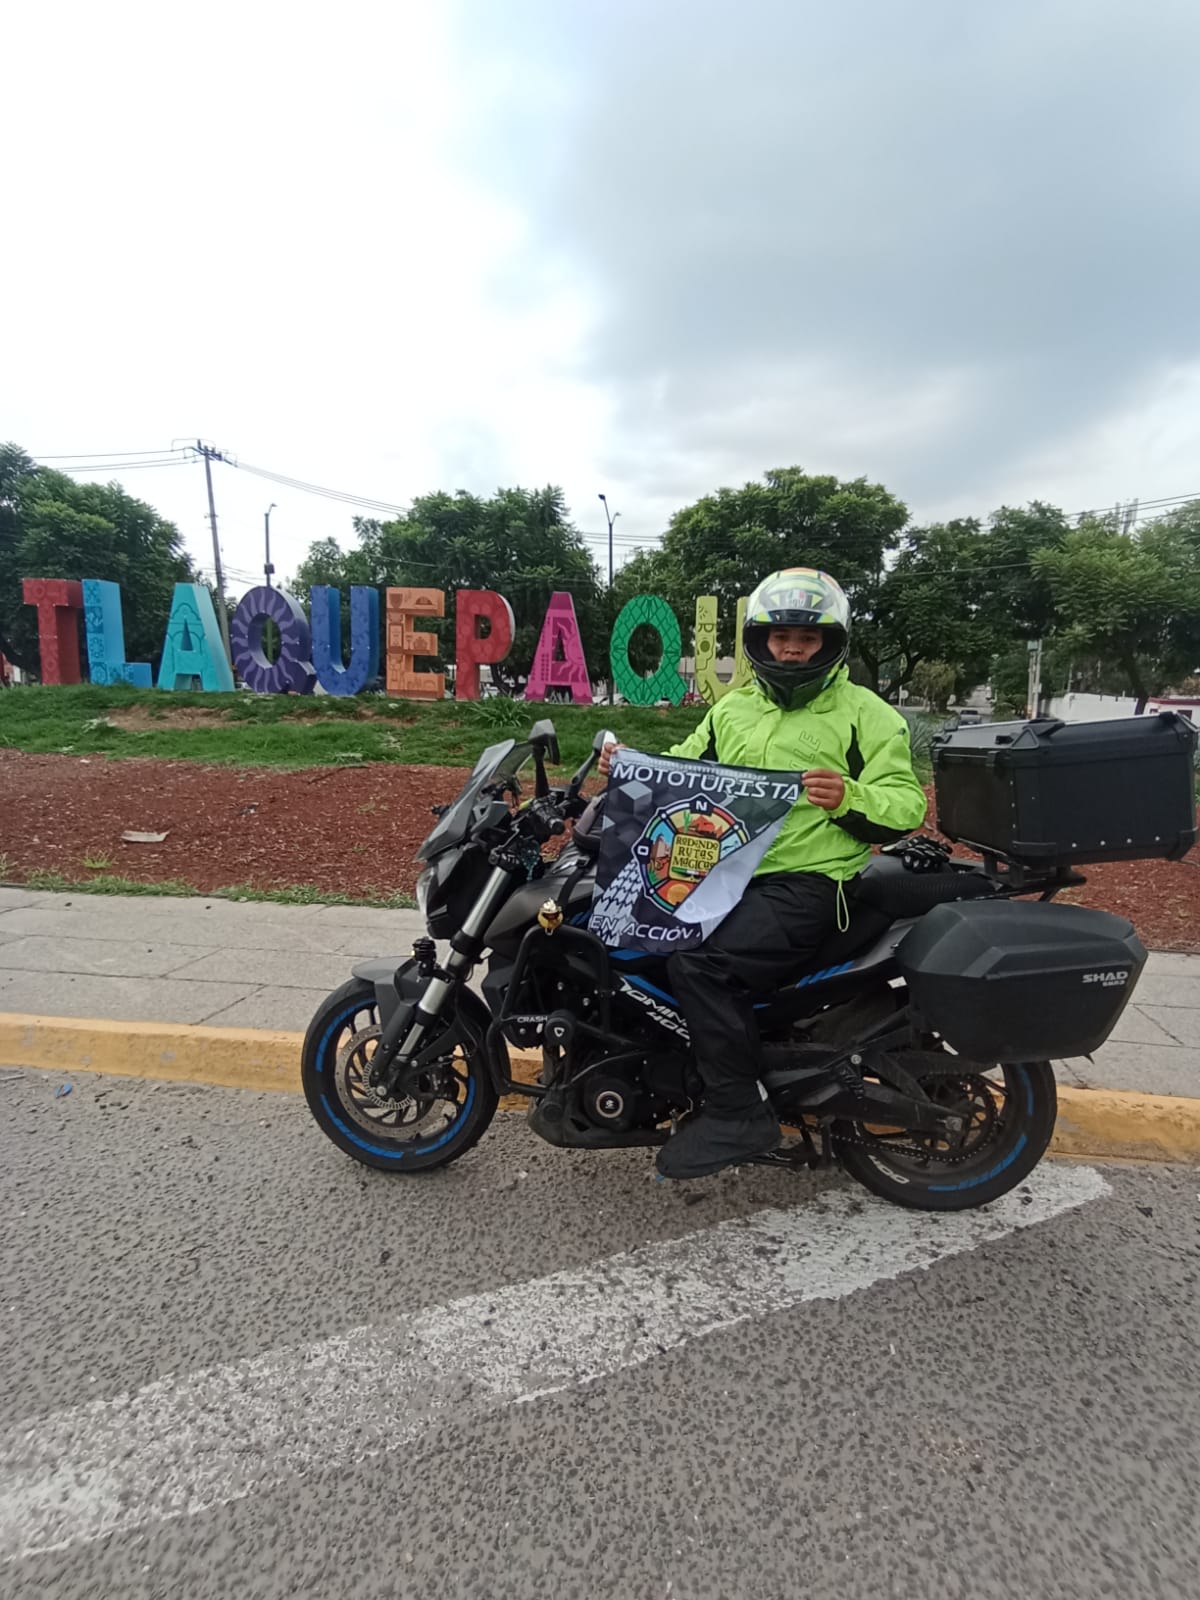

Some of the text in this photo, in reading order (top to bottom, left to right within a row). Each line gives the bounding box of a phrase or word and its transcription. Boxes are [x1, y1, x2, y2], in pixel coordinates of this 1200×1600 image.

[22, 577, 750, 707] TLAQUEPAQU
[612, 762, 800, 801] MOTOTURISTA
[695, 800, 708, 812] N
[590, 914, 694, 942] EN ACCIÓN
[1082, 971, 1129, 984] SHAD
[516, 1016, 548, 1024] CRASH
